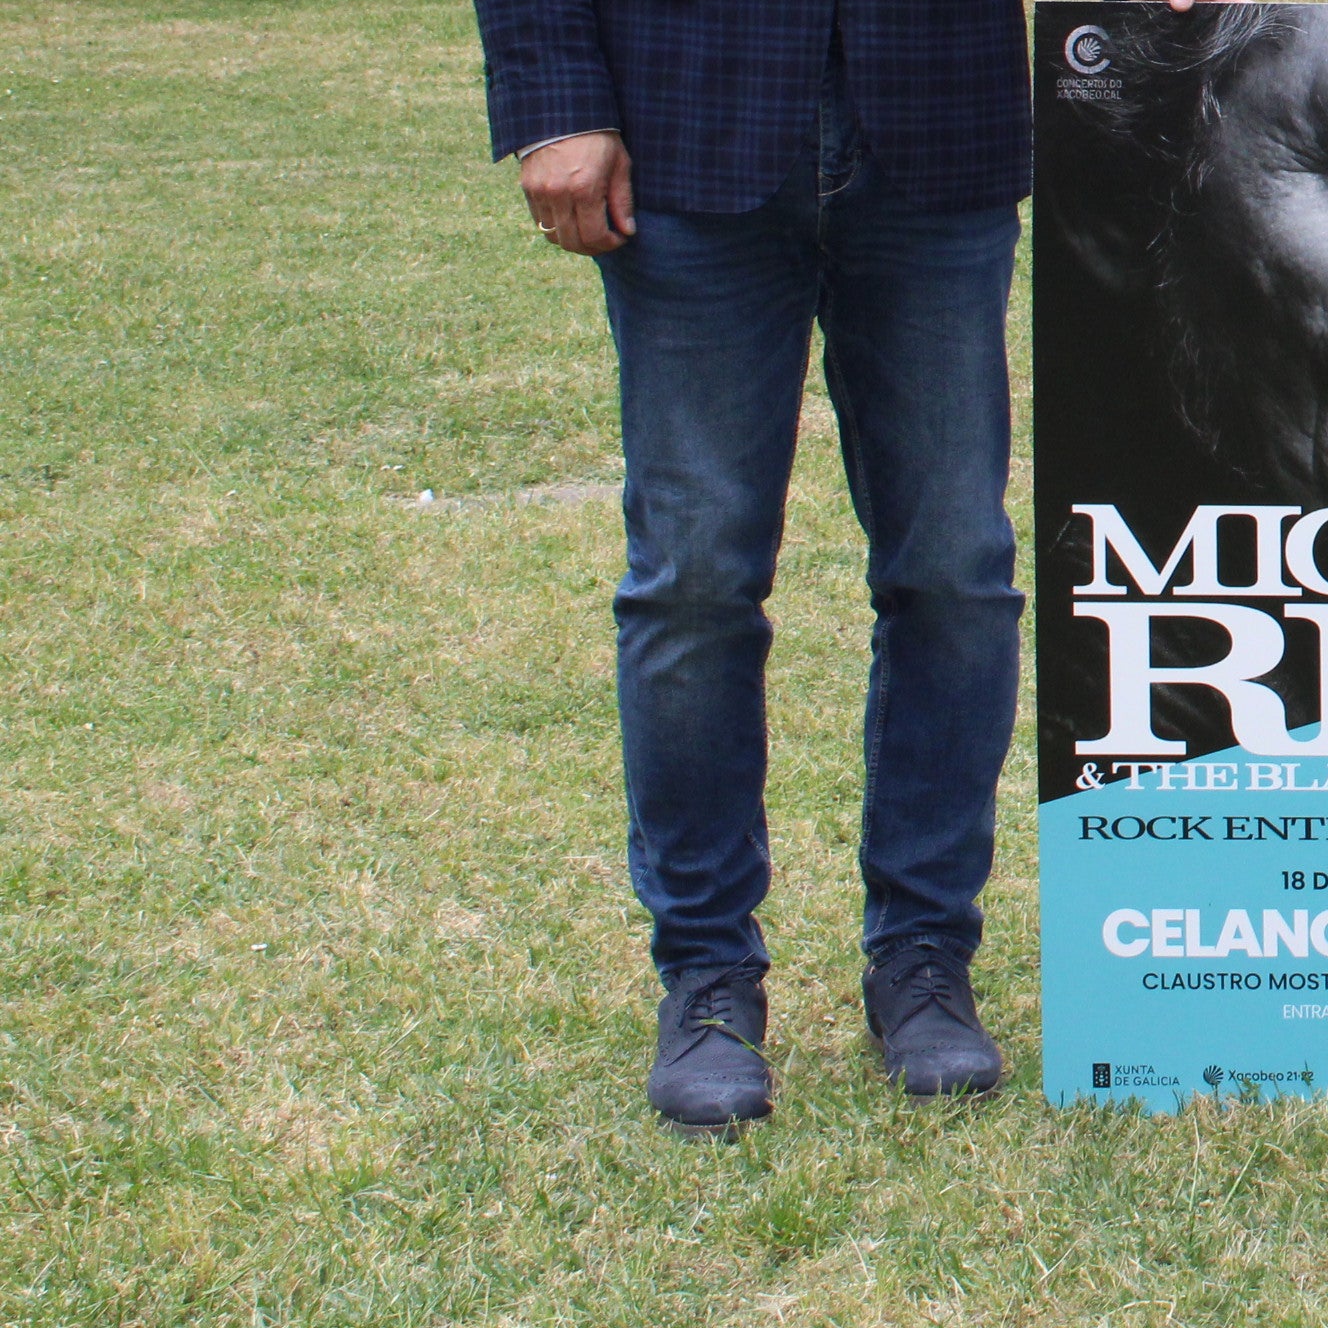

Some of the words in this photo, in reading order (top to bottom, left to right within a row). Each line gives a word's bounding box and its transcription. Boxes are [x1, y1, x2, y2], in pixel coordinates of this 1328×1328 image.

[1056, 78, 1107, 89] CONCERTOS
[1109, 79, 1122, 89] DO
[1075, 763, 1106, 790] &
[1112, 762, 1239, 791] THE
[1078, 816, 1214, 840] ROCK
[1281, 871, 1305, 890] 18
[1142, 973, 1261, 991] CLAUSTRO
[1115, 1064, 1155, 1075] XUNTA
[1228, 1070, 1284, 1082] Xacobeo
[1115, 1076, 1131, 1086] DE
[1133, 1076, 1180, 1087] GALICIA
